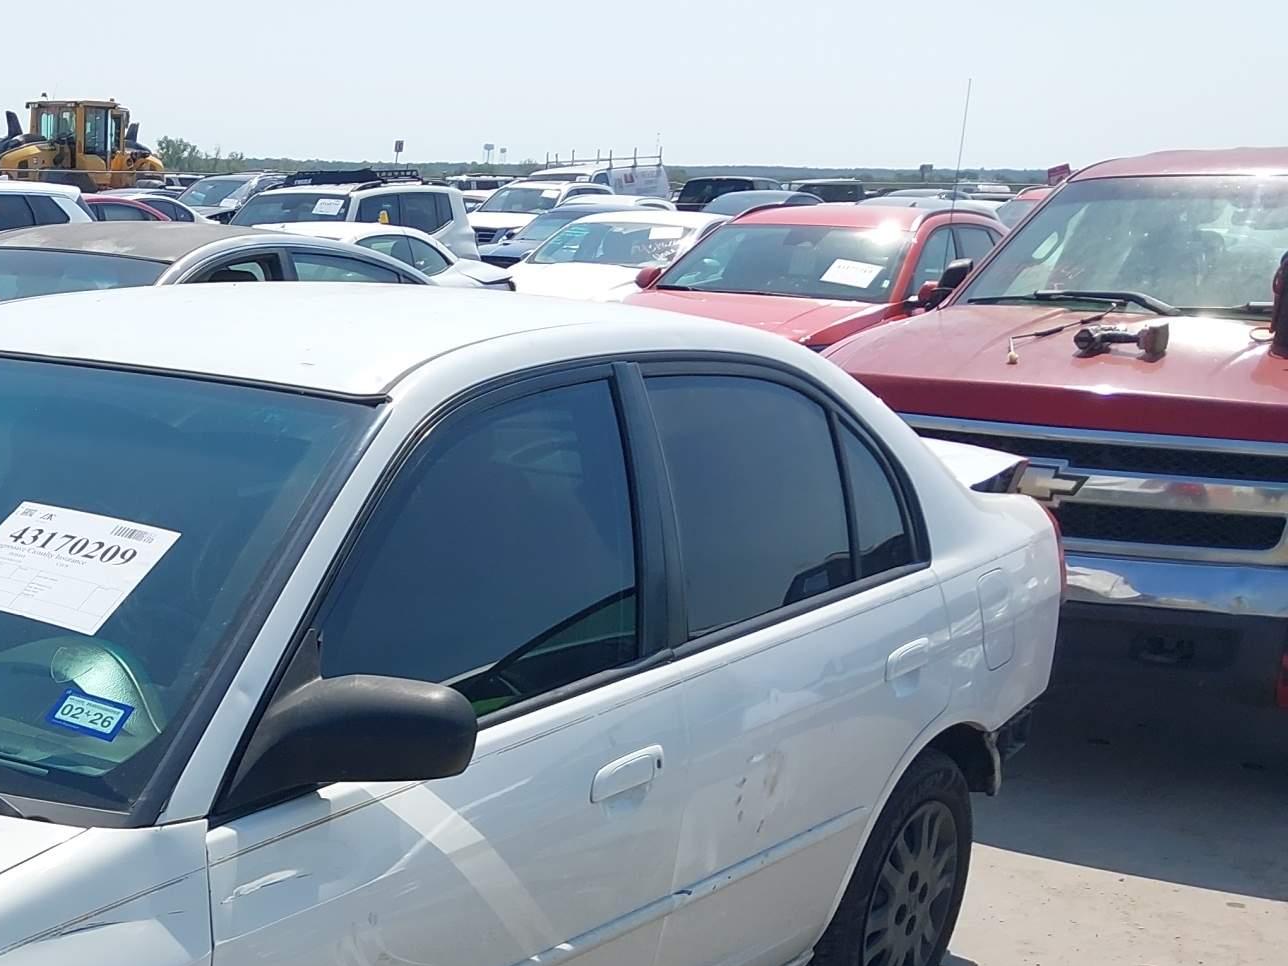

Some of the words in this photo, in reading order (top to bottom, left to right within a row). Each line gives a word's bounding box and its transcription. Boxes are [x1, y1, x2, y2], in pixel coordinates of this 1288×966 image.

[9, 525, 138, 567] 43170209
[27, 547, 54, 560] Casualty
[55, 554, 88, 567] Insurance
[60, 703, 85, 720] 02
[88, 712, 114, 729] 26
